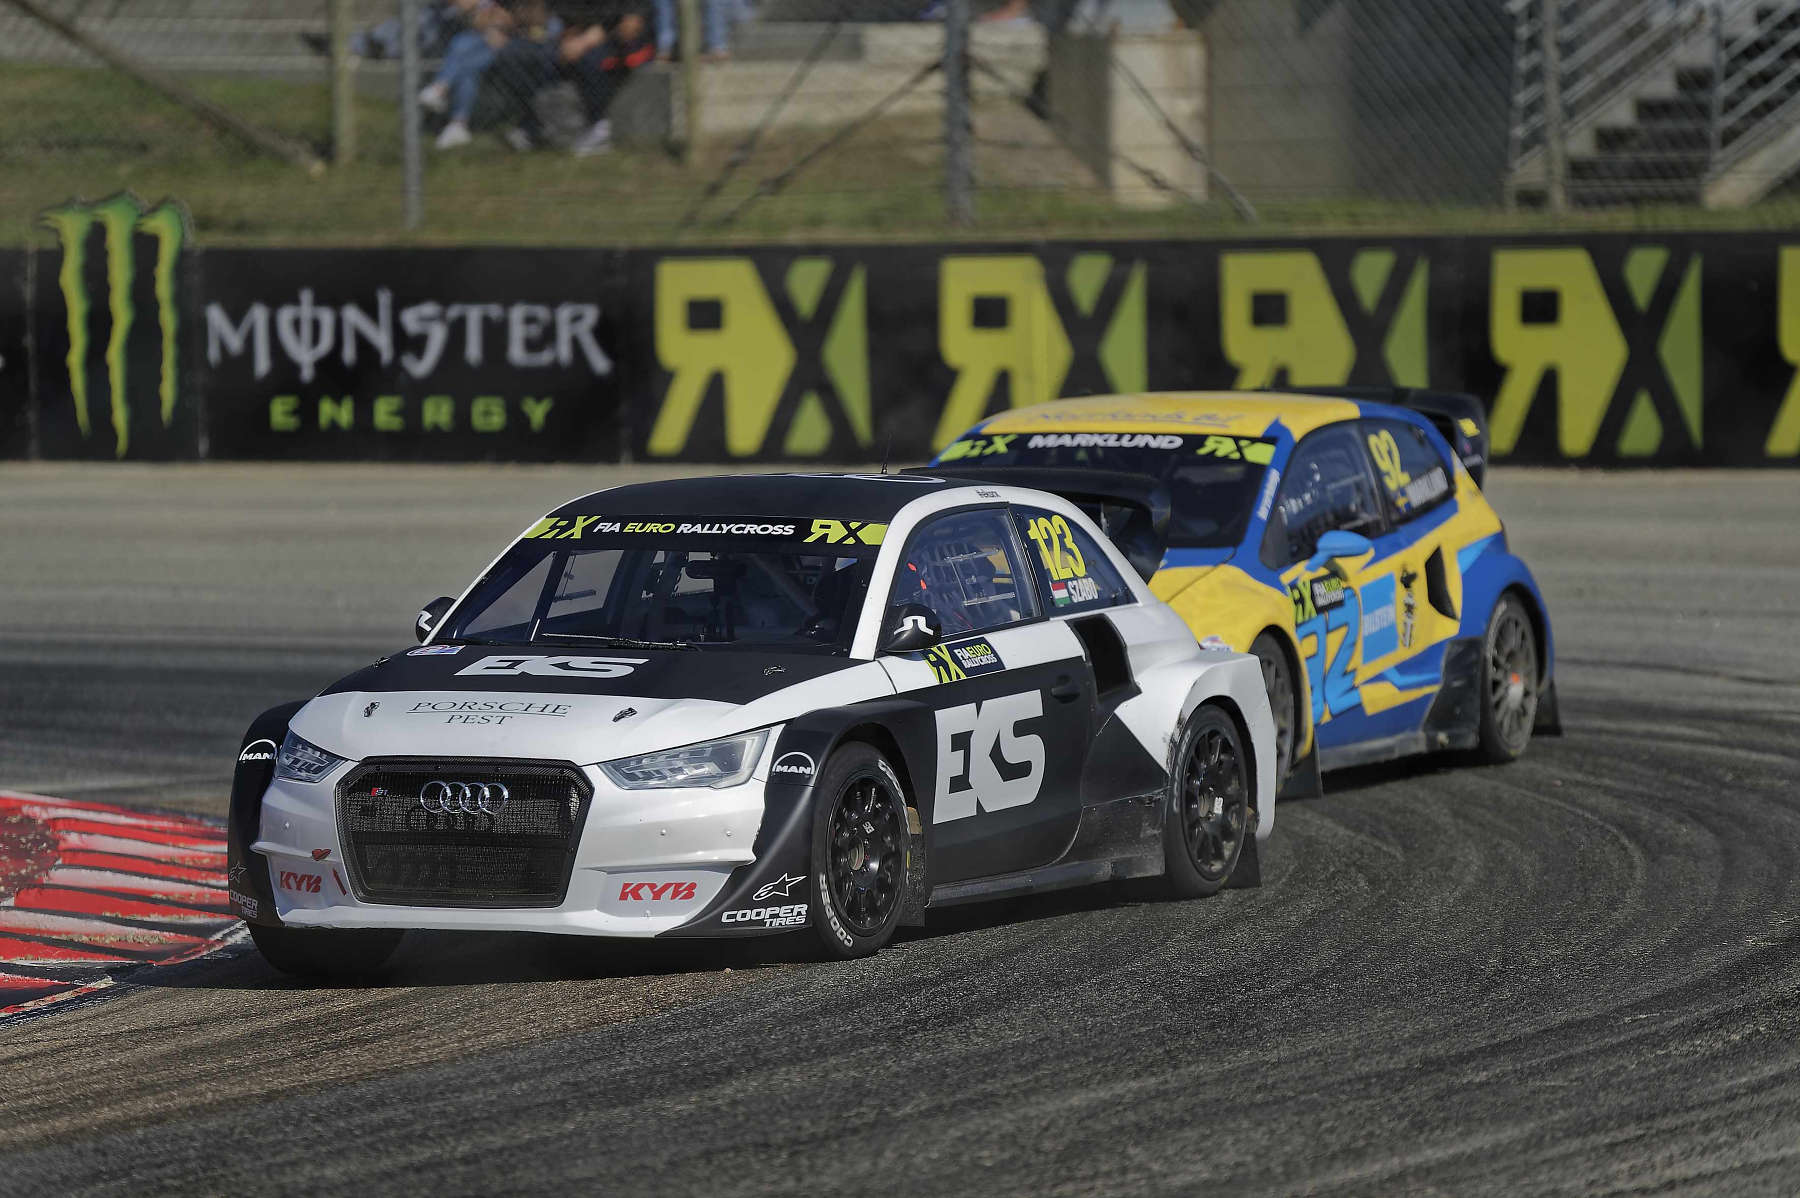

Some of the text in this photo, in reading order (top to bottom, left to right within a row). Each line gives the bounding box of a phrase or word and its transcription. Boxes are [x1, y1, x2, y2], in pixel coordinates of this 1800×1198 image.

[205, 287, 612, 383] MONSTER
[269, 395, 552, 432] ENERGY
[1028, 434, 1183, 450] MARKLUND
[592, 522, 620, 533] FIA
[623, 522, 675, 534] EURO
[676, 523, 796, 536] RALLYCROSS
[1027, 514, 1086, 580] 123
[966, 643, 992, 658] EURO
[453, 655, 650, 679] EKS
[411, 701, 572, 715] PORSCHE
[444, 714, 512, 725] PEST
[242, 752, 273, 761] MAN
[933, 688, 1046, 825] EKS
[775, 765, 812, 775] MAN
[280, 871, 322, 893] KYB
[618, 881, 697, 901] KYB
[229, 888, 258, 910] COOPER
[721, 903, 808, 924] COOPER
[764, 915, 806, 928] TIRES
